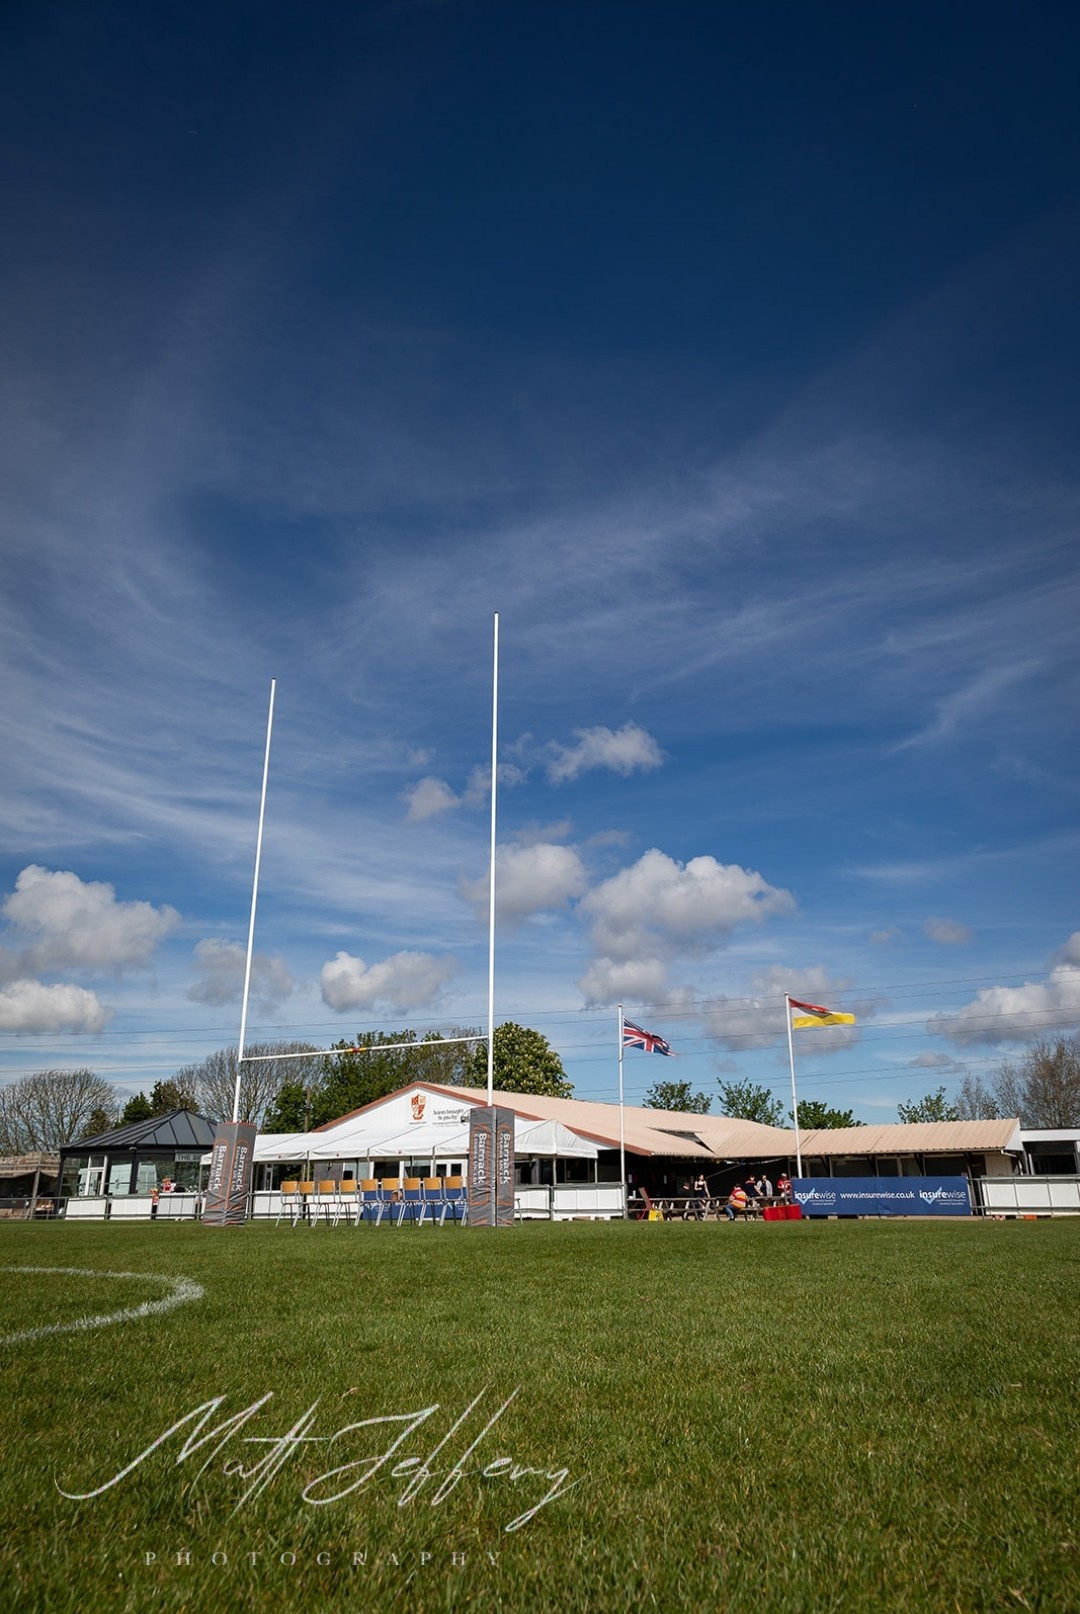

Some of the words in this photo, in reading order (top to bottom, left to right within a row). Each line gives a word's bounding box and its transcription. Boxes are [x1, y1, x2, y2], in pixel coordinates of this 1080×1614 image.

[213, 1146, 227, 1190] Barnack
[236, 1147, 248, 1191] Barnack
[478, 1133, 487, 1184] Barnack
[794, 1190, 836, 1199] insurewise
[840, 1191, 915, 1199] www.insurewise.co.uk
[919, 1190, 966, 1198] insurewise
